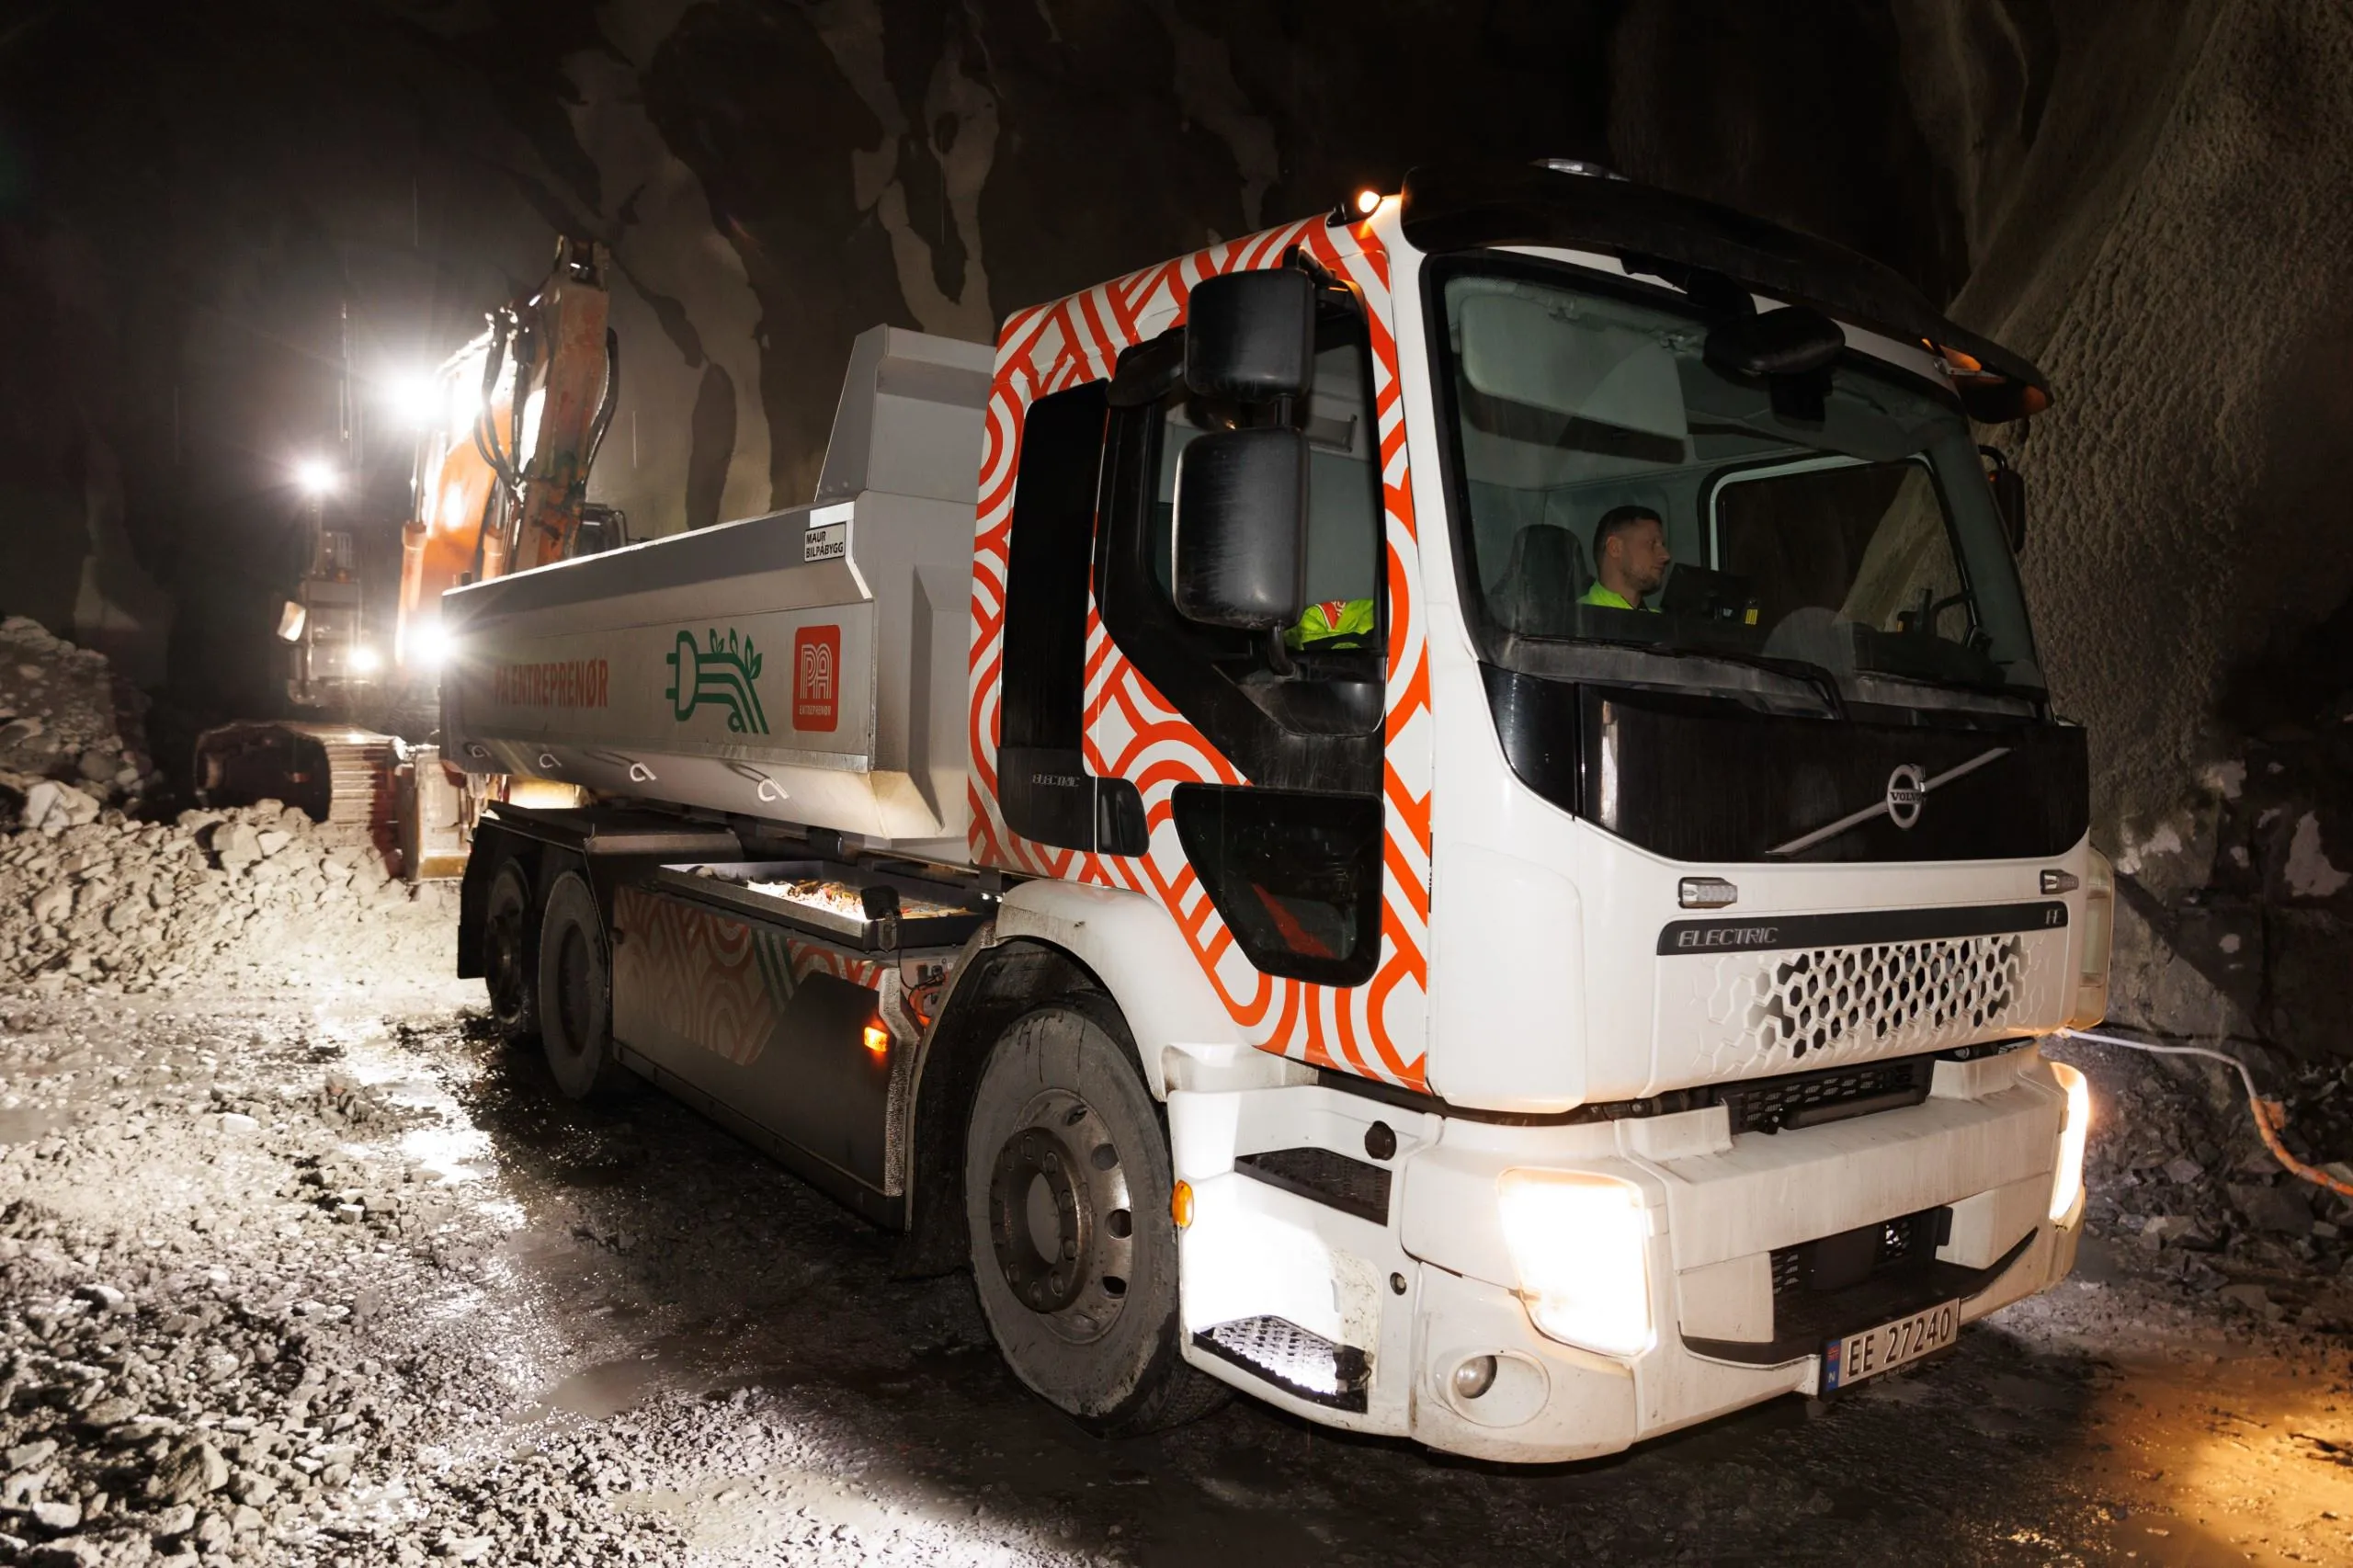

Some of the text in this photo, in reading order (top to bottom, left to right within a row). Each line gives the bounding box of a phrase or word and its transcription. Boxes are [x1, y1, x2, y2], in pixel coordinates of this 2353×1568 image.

[806, 531, 826, 544] MAUR
[512, 657, 608, 708] ENTREPRENØR
[800, 642, 833, 699] PA
[1677, 926, 1779, 948] ELECTRIC
[1828, 1370, 1836, 1383] N
[1847, 1335, 1875, 1378] EE
[1884, 1307, 1950, 1365] 27240
